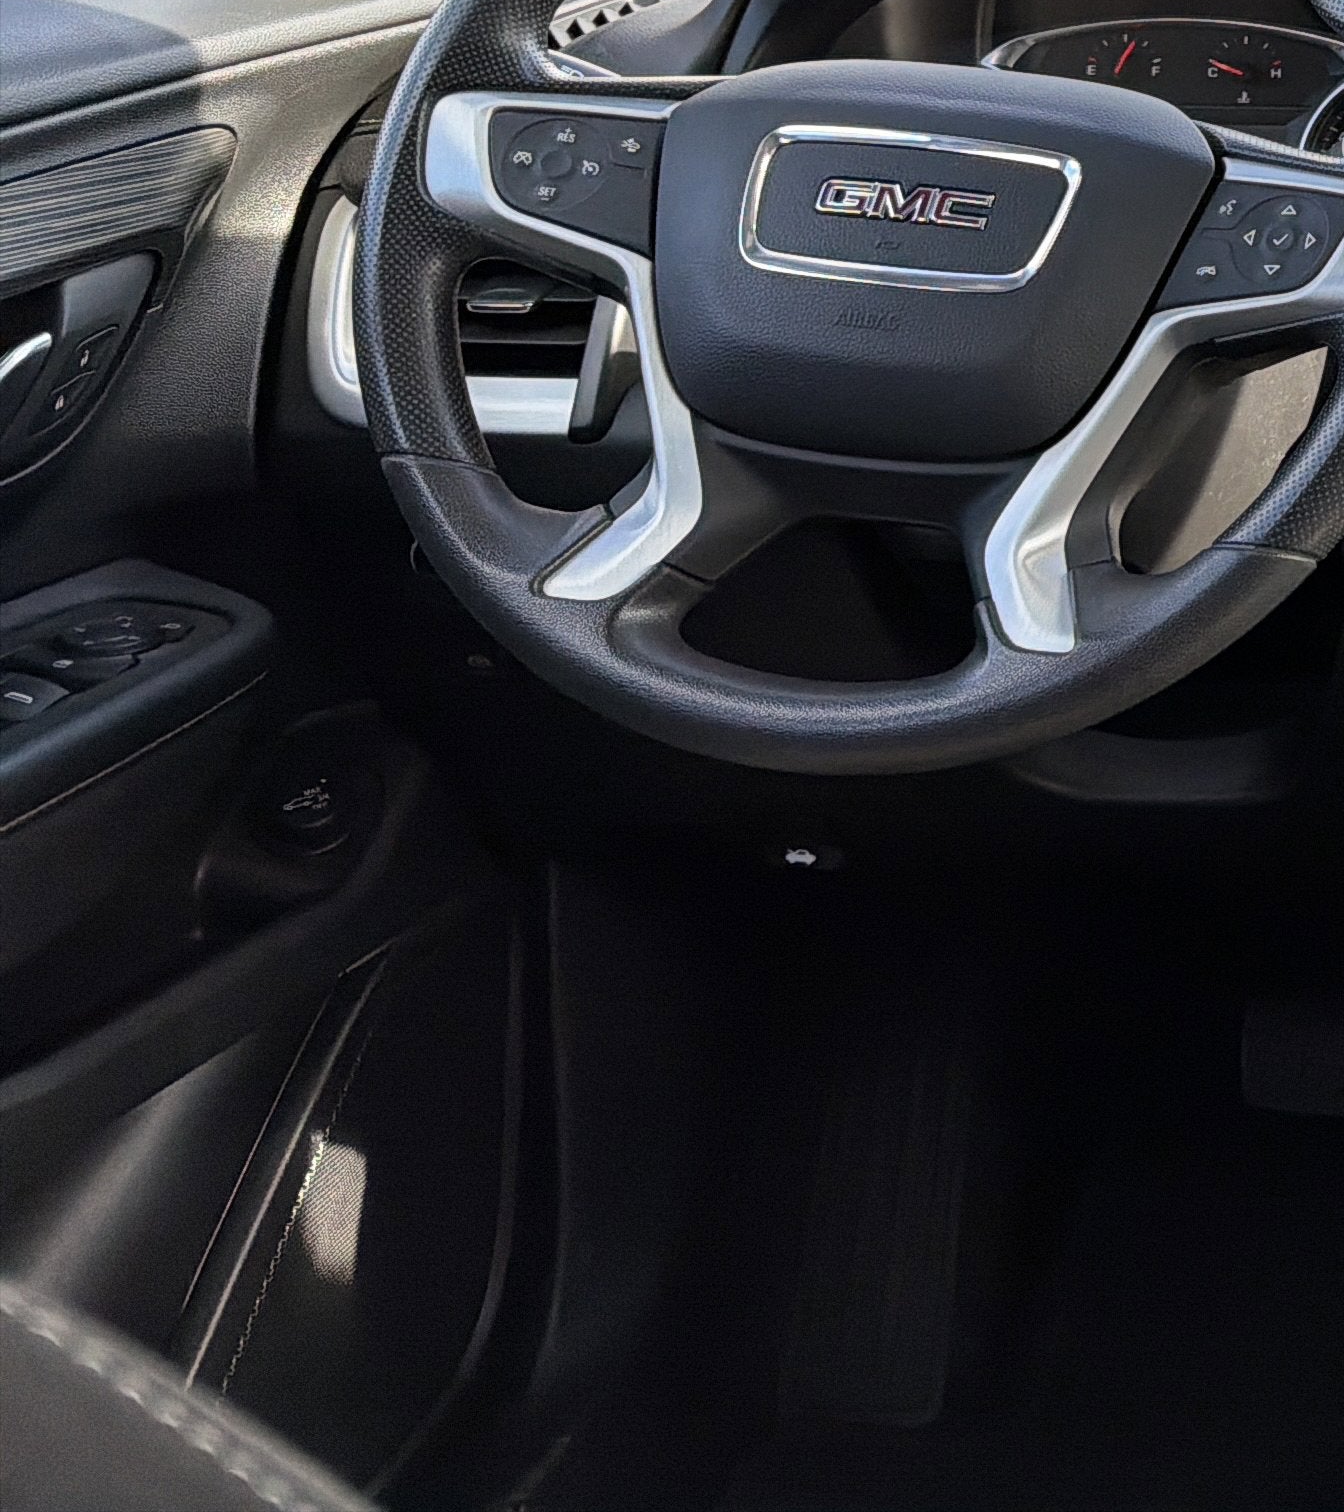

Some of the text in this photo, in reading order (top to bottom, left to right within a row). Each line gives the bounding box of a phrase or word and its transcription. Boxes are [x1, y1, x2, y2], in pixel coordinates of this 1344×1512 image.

[1086, 64, 1097, 76] E
[1152, 66, 1161, 77] F
[1207, 67, 1219, 78] C
[1271, 67, 1282, 79] H
[557, 133, 576, 143] RES
[538, 186, 556, 196] SET
[815, 179, 996, 231] GMC
[832, 308, 900, 329] AIRBAG
